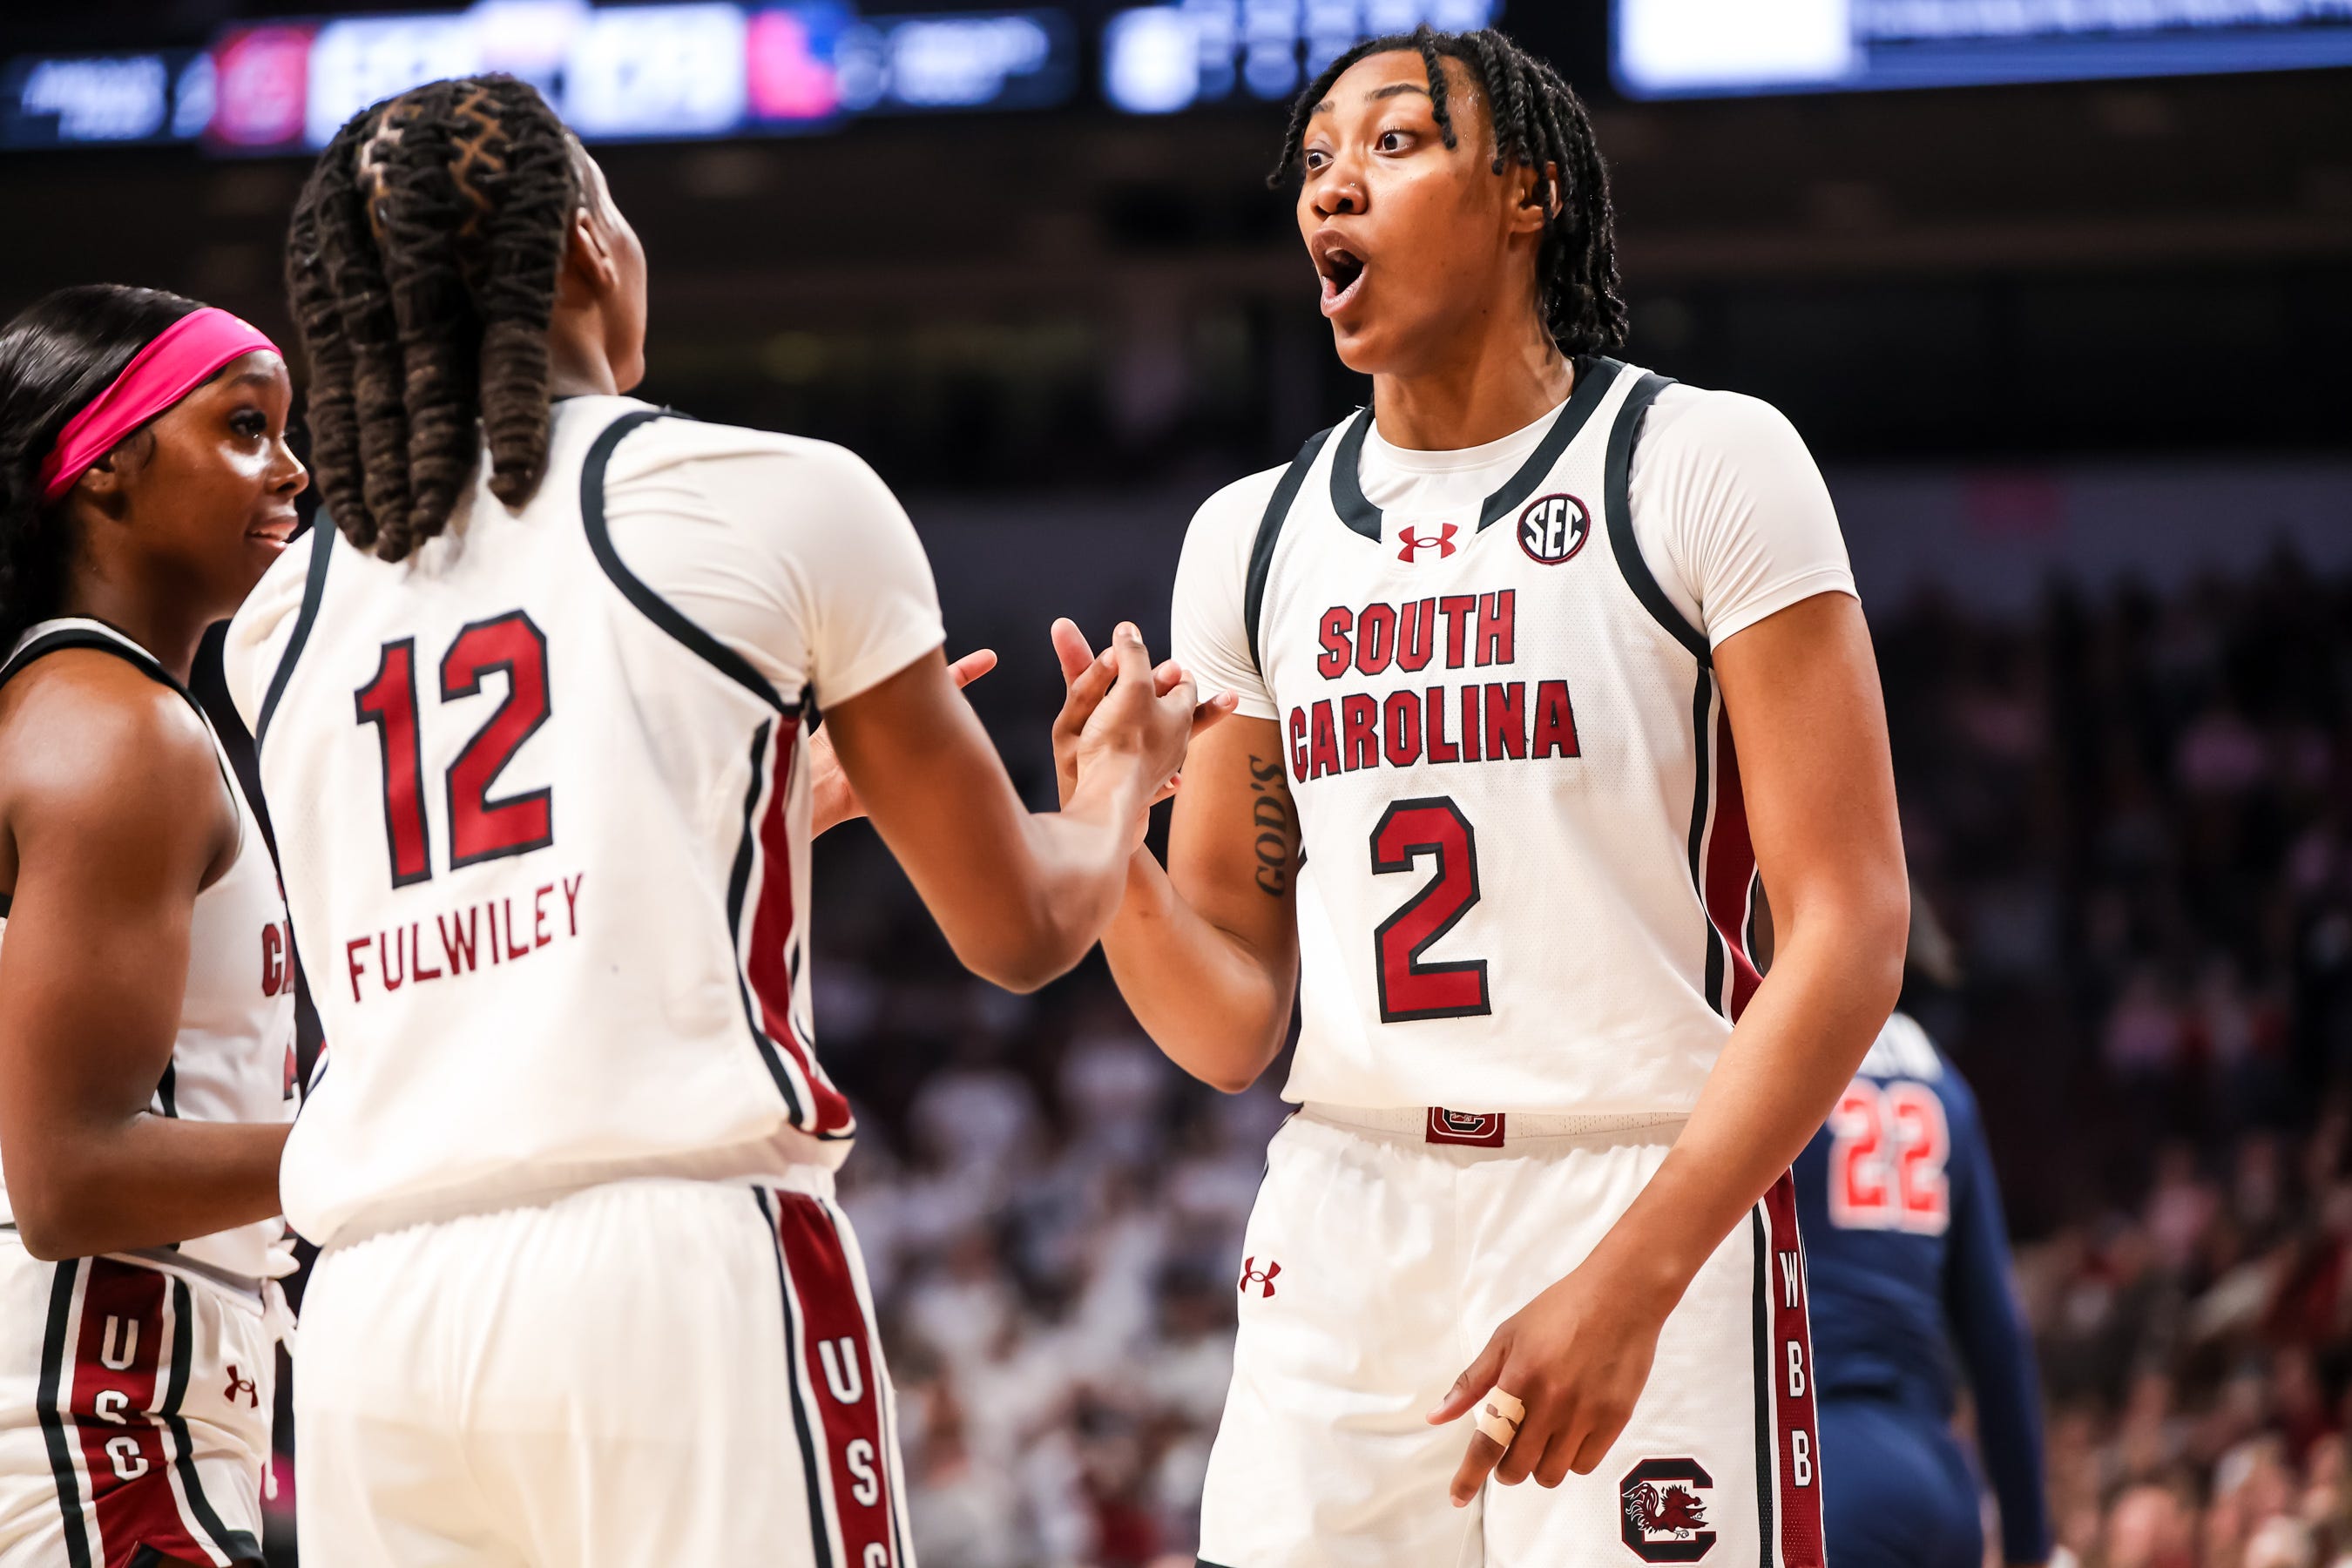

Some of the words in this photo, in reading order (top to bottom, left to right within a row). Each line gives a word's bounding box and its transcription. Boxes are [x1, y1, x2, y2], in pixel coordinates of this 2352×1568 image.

[1524, 497, 1584, 558] SEC
[1317, 588, 1517, 680] SOUTH
[354, 608, 554, 890] 12
[1289, 679, 1582, 784] CAROLINA
[1248, 754, 1288, 898] GOD'S
[346, 872, 584, 1004] FULWILEY
[1369, 795, 1492, 1024] 2
[1827, 1077, 1951, 1236] 22
[1779, 1251, 1812, 1487] WBB
